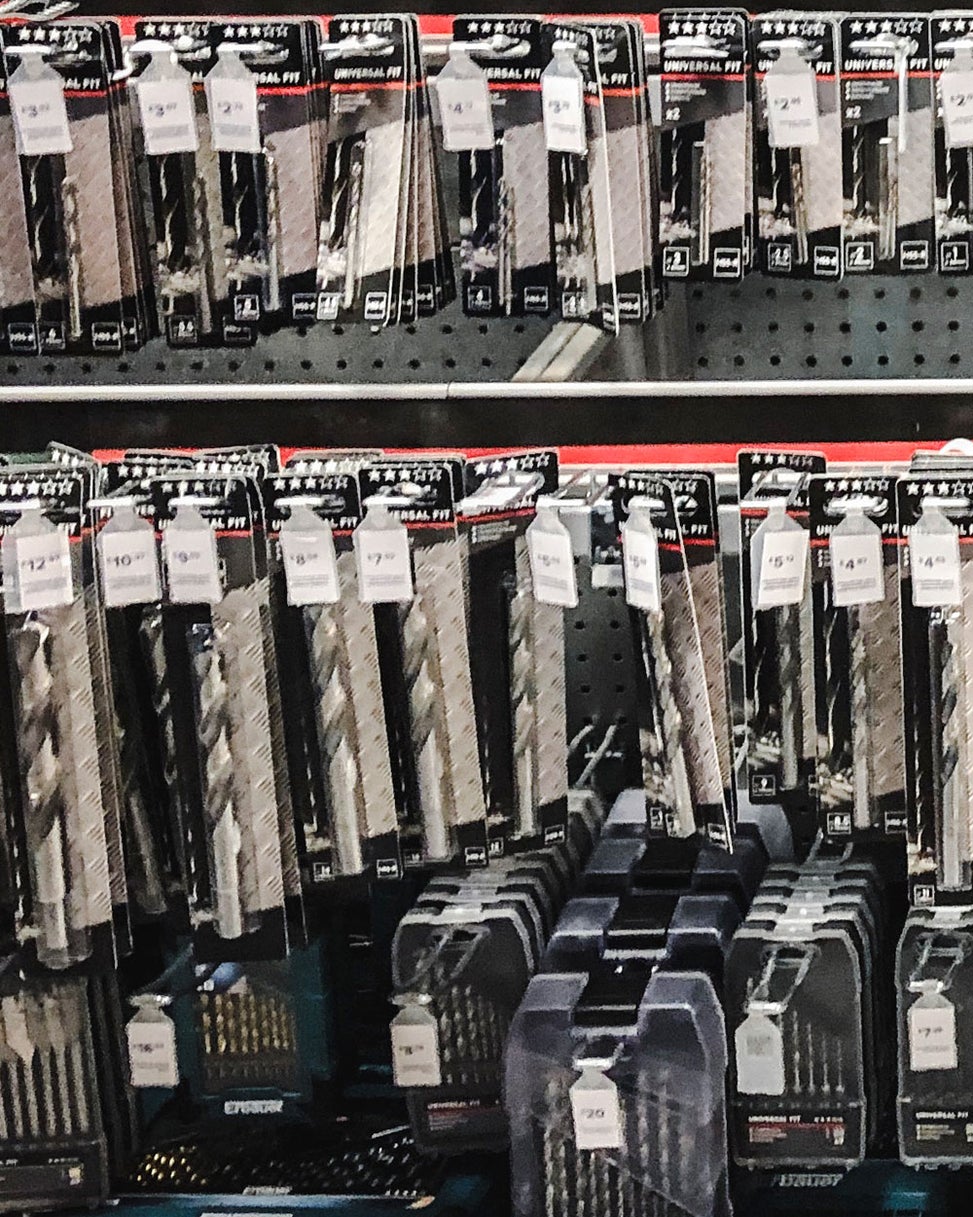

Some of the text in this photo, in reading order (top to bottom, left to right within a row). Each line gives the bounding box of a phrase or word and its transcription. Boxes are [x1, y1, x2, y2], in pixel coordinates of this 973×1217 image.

[663, 60, 741, 72] UNIVERSAL FIT
[816, 61, 832, 73] FIT
[844, 58, 928, 71] UNIVERS FIT
[282, 71, 300, 83] FIT
[334, 67, 401, 81] UNIVERSAL FIT
[522, 67, 541, 79] FIT
[611, 72, 628, 84] FIT
[83, 78, 100, 90] FIT
[432, 509, 450, 521] FIT
[227, 517, 246, 528] FIT
[340, 517, 358, 529] FIT
[691, 524, 708, 536] FIT
